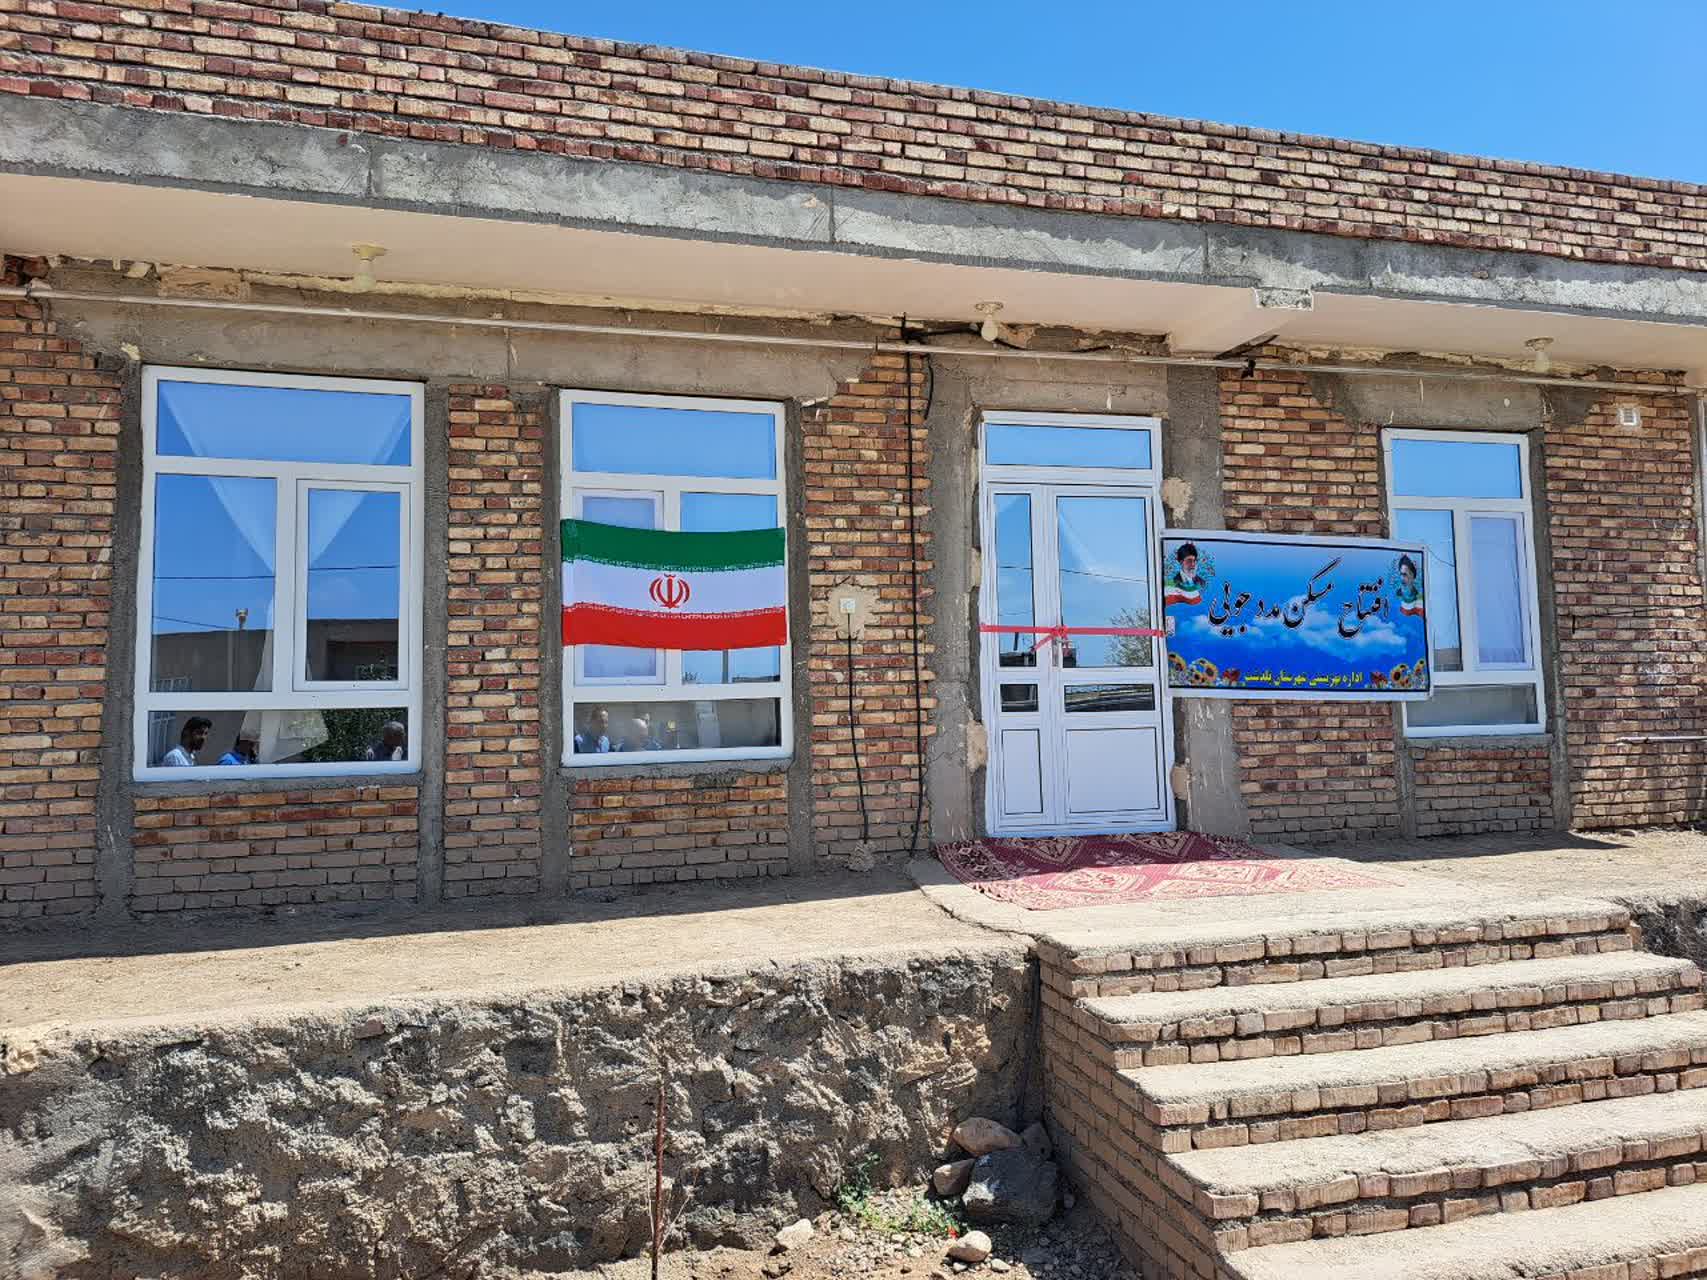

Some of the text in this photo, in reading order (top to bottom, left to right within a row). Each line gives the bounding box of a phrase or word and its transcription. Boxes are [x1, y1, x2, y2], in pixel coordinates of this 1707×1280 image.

[1281, 553, 1343, 630] مسکن
[1337, 576, 1390, 640] افتتاح
[1274, 670, 1307, 687] شهرستان
[1309, 672, 1342, 688] بهزیستی
[1342, 671, 1363, 688] اداره
